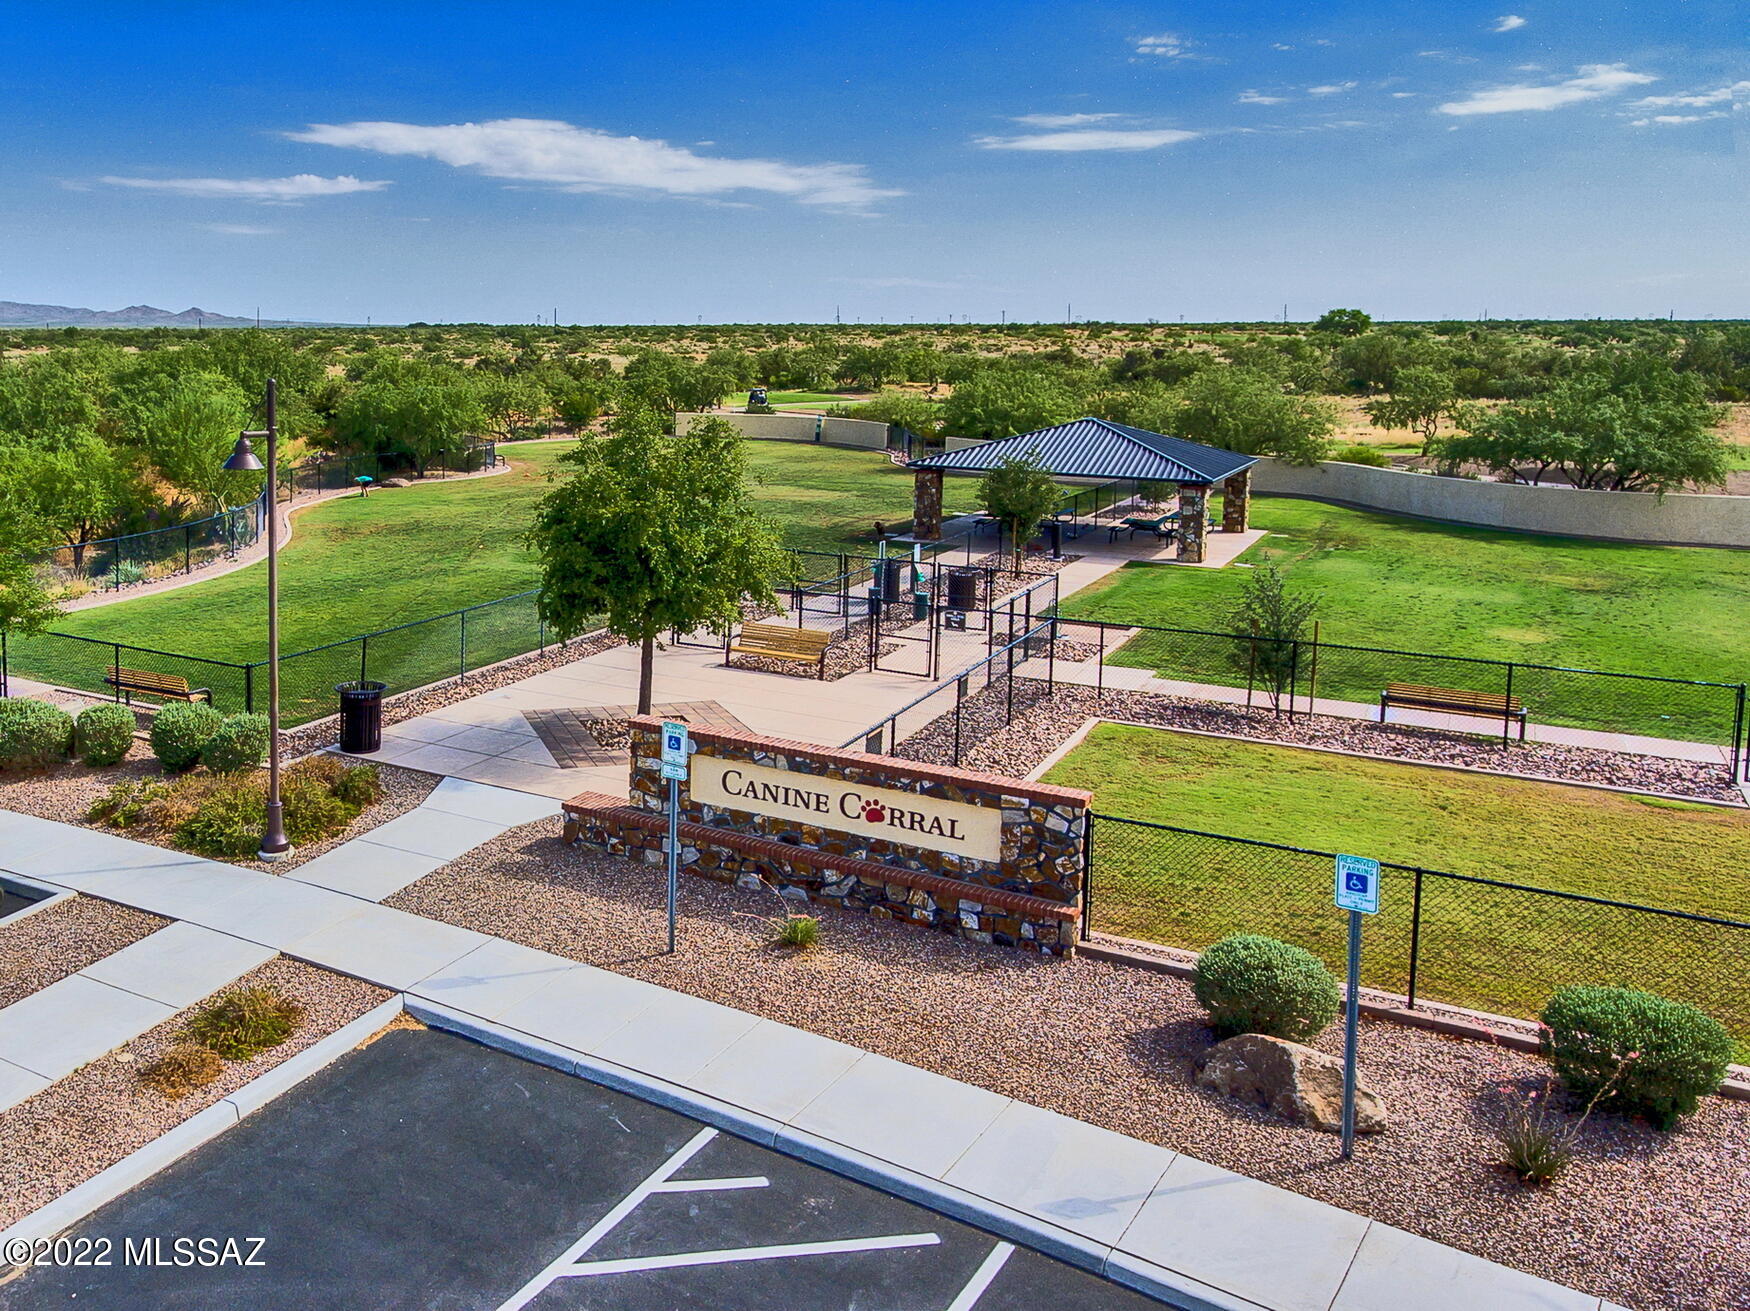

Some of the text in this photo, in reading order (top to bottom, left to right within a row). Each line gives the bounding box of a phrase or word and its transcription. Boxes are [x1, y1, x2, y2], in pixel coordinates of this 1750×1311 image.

[721, 769, 966, 841] CANINE CRRAL
[1339, 855, 1376, 868] RESERVED
[1342, 864, 1374, 876] PARKING
